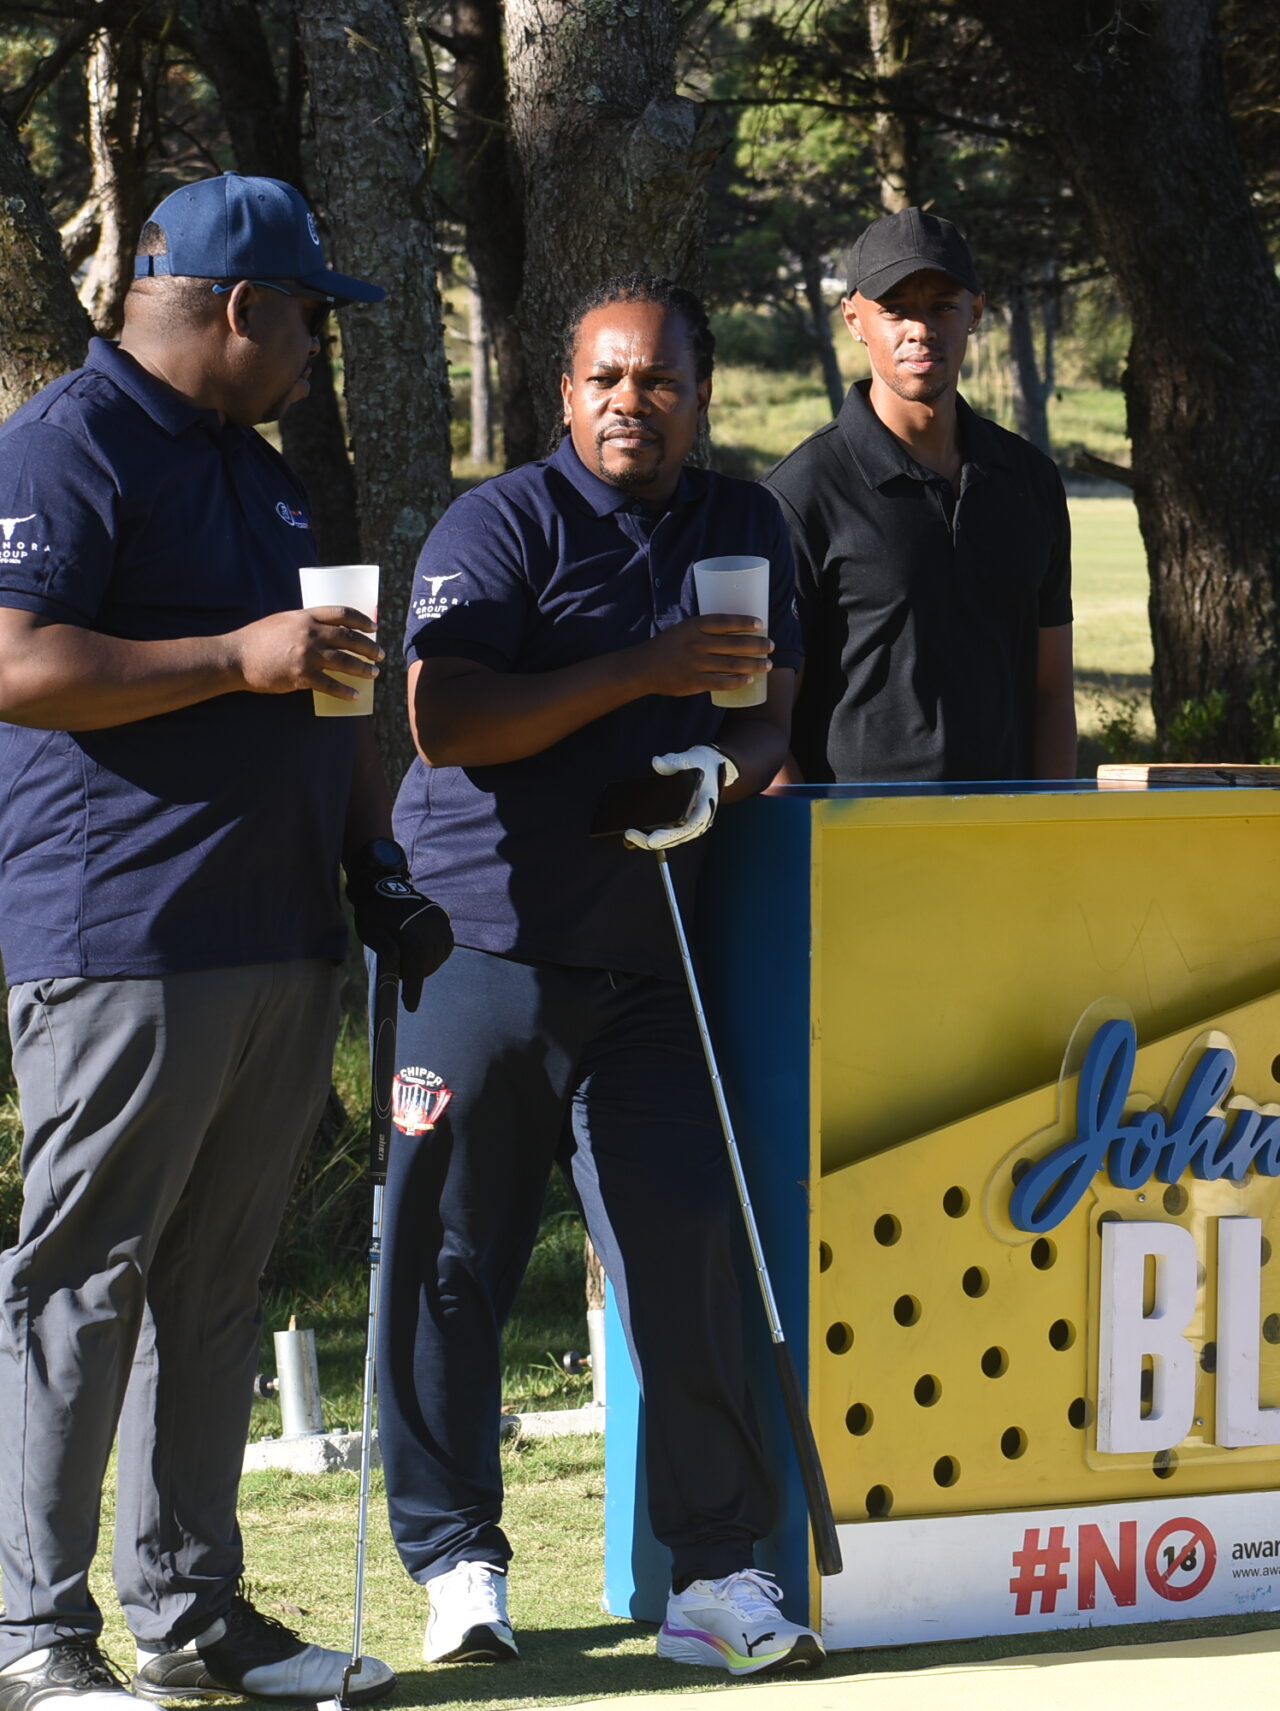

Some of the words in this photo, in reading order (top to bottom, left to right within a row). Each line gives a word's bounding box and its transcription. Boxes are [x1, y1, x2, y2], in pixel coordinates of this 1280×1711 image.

[2, 541, 51, 552] NORA
[0, 550, 28, 559] OUP
[415, 605, 449, 615] GROUP
[400, 1066, 444, 1087] CHIPPA
